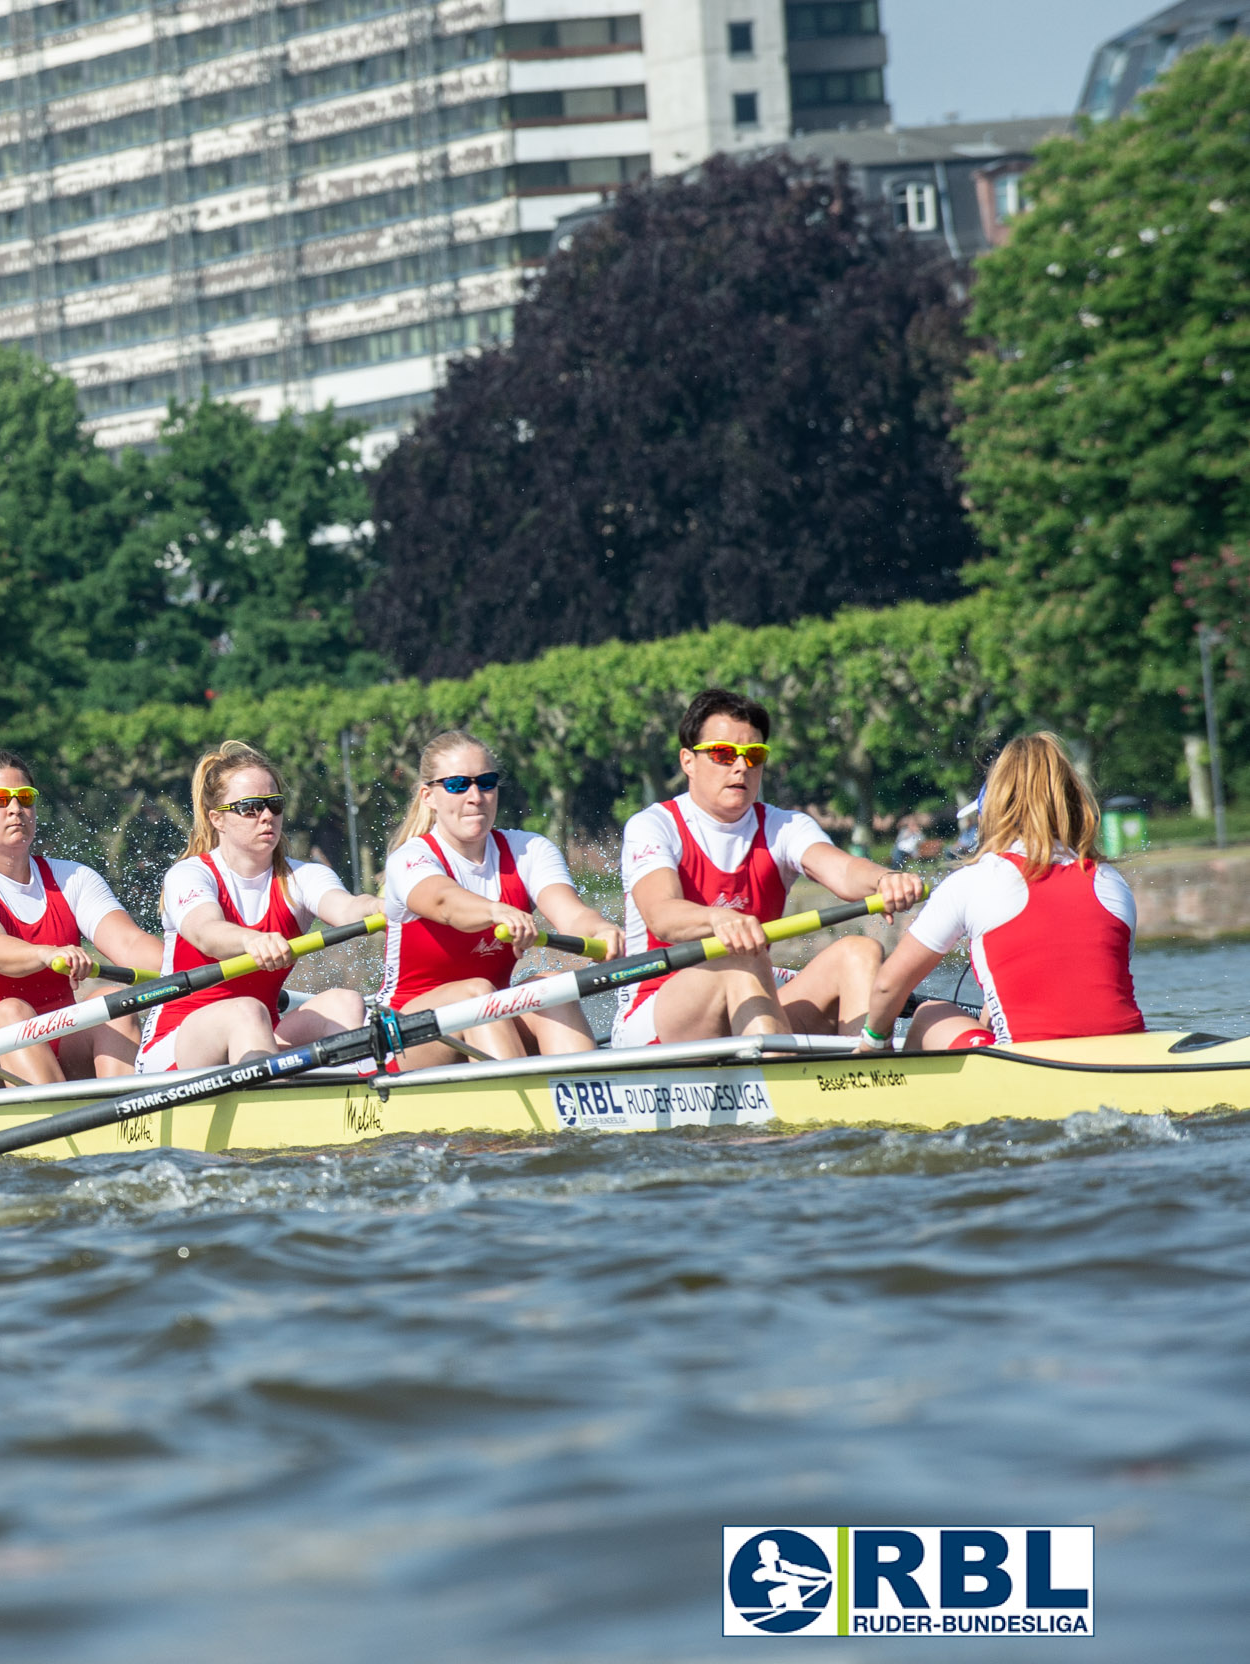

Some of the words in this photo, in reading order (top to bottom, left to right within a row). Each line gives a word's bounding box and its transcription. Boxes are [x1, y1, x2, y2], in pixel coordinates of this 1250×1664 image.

[473, 988, 546, 1024] Melitta
[14, 1010, 78, 1046] Melitta
[122, 1092, 168, 1114] STARK.
[166, 1075, 231, 1099] SCHNELL.
[231, 1065, 263, 1083] GUT.
[277, 1053, 303, 1069] RBL
[870, 1069, 908, 1088] Minden
[343, 1088, 384, 1135] Melitta
[574, 1080, 624, 1115] RBL
[624, 1083, 770, 1114] RUDER-BUNDESLIGA
